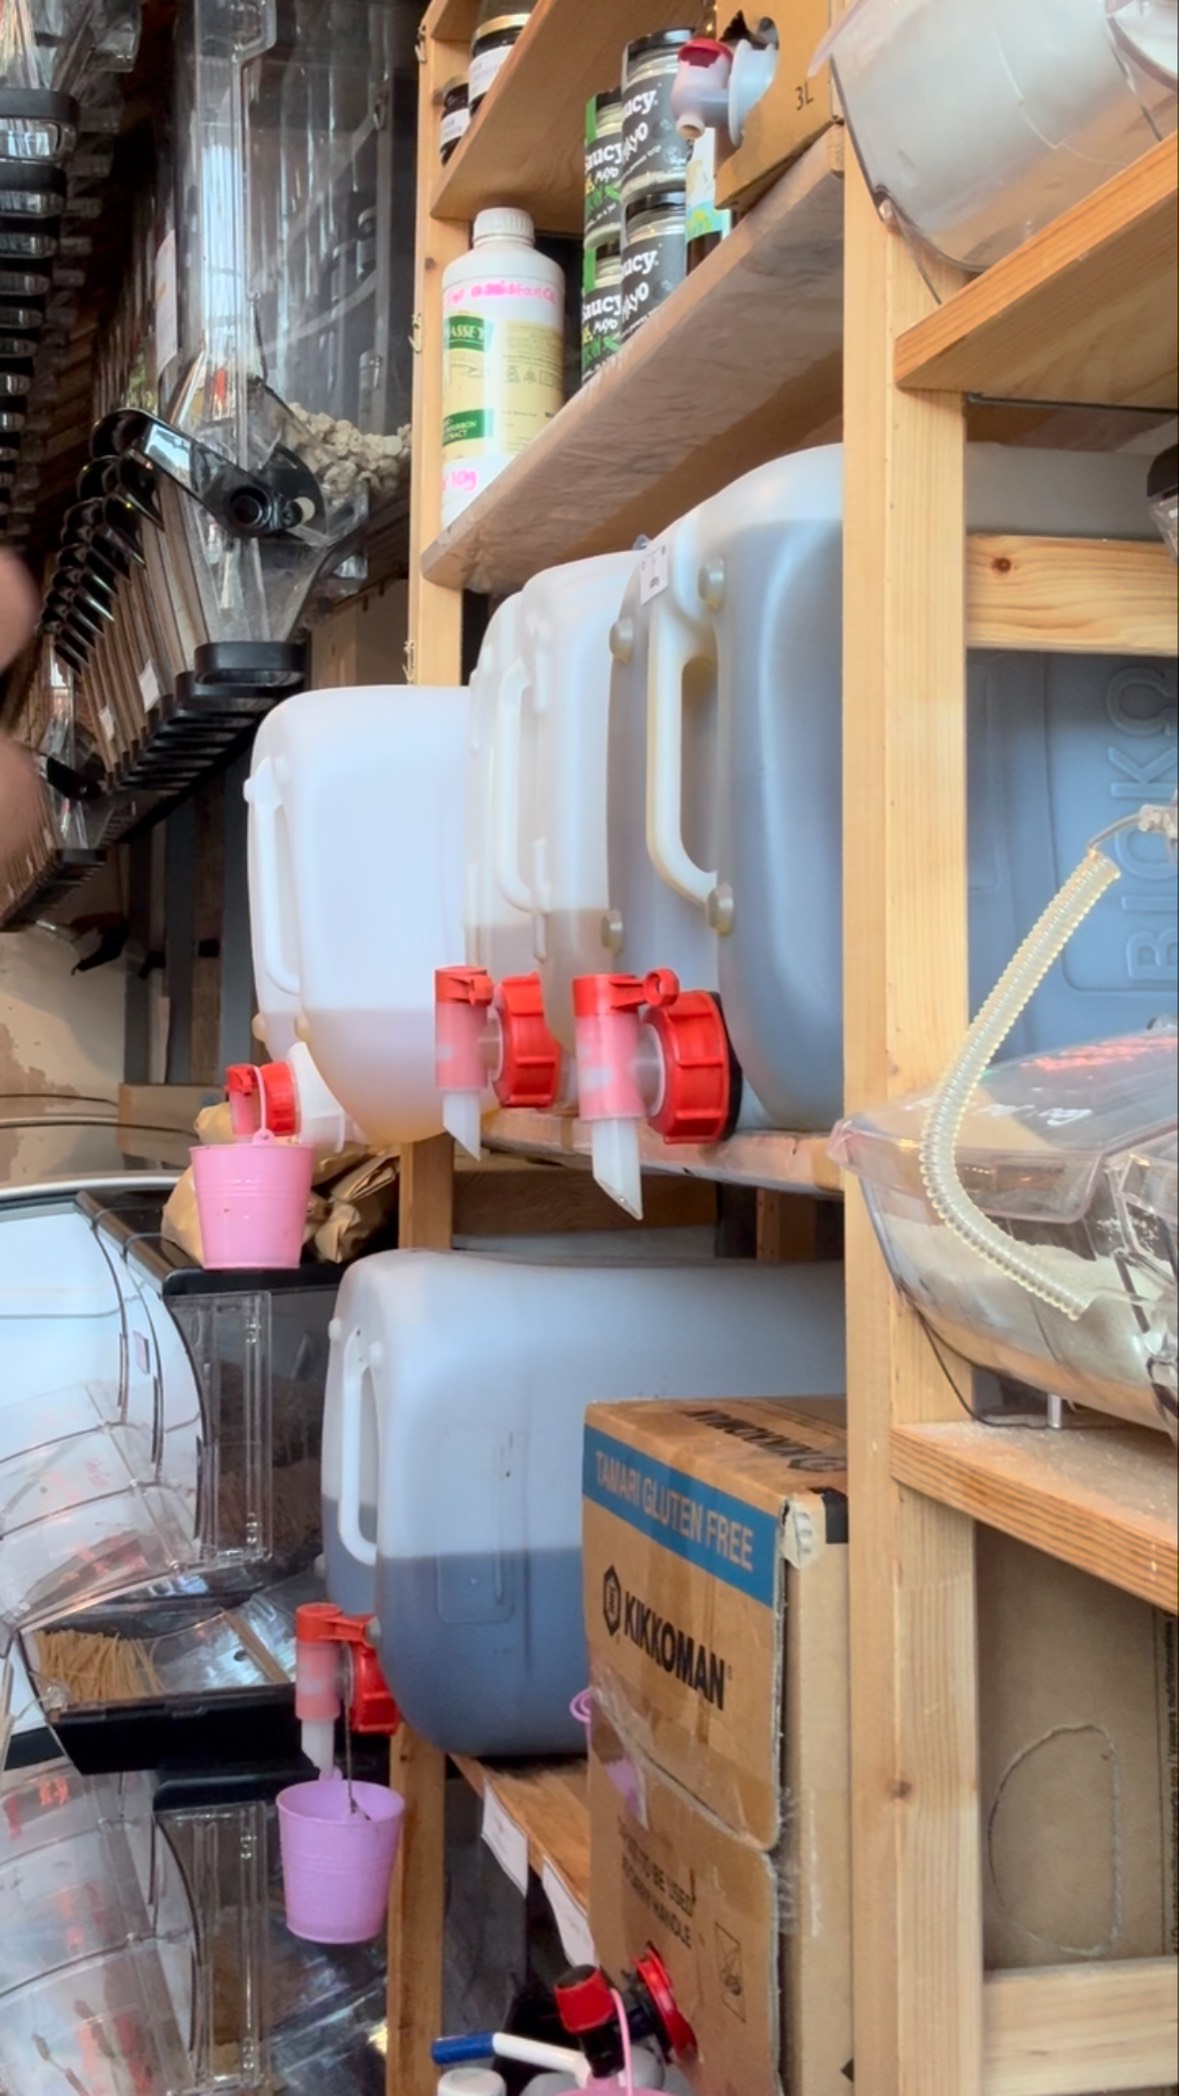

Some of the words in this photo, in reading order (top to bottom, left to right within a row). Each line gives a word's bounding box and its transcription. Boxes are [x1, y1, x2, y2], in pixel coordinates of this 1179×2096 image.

[795, 81, 814, 111] 3L
[595, 1450, 641, 1509] TAMARI
[642, 1478, 702, 1546] GLUTEN
[706, 1511, 753, 1573] FREE
[624, 1590, 725, 1711] KIKKOMAN
